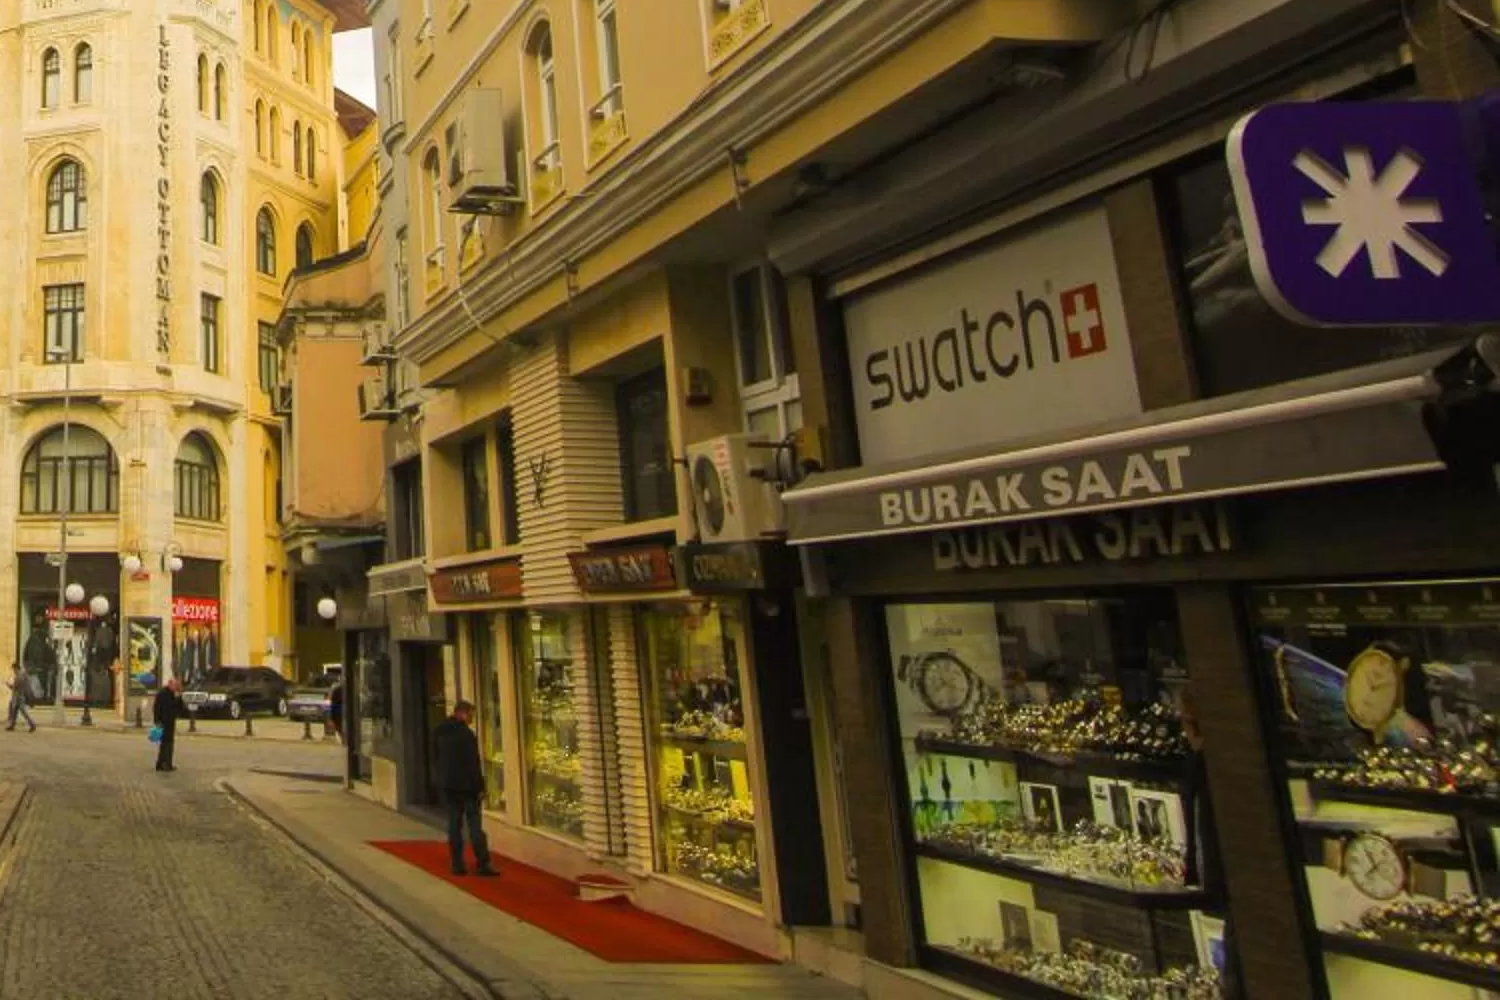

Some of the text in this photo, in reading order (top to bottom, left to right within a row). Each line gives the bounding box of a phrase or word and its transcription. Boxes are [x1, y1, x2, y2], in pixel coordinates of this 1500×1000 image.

[157, 24, 170, 167] LEGACY
[156, 177, 171, 353] OTTOMAN
[866, 289, 1060, 411] swatch
[880, 445, 1192, 526] BURAK SAAT
[932, 518, 1085, 571] BURAK
[172, 599, 219, 621] ollezione
